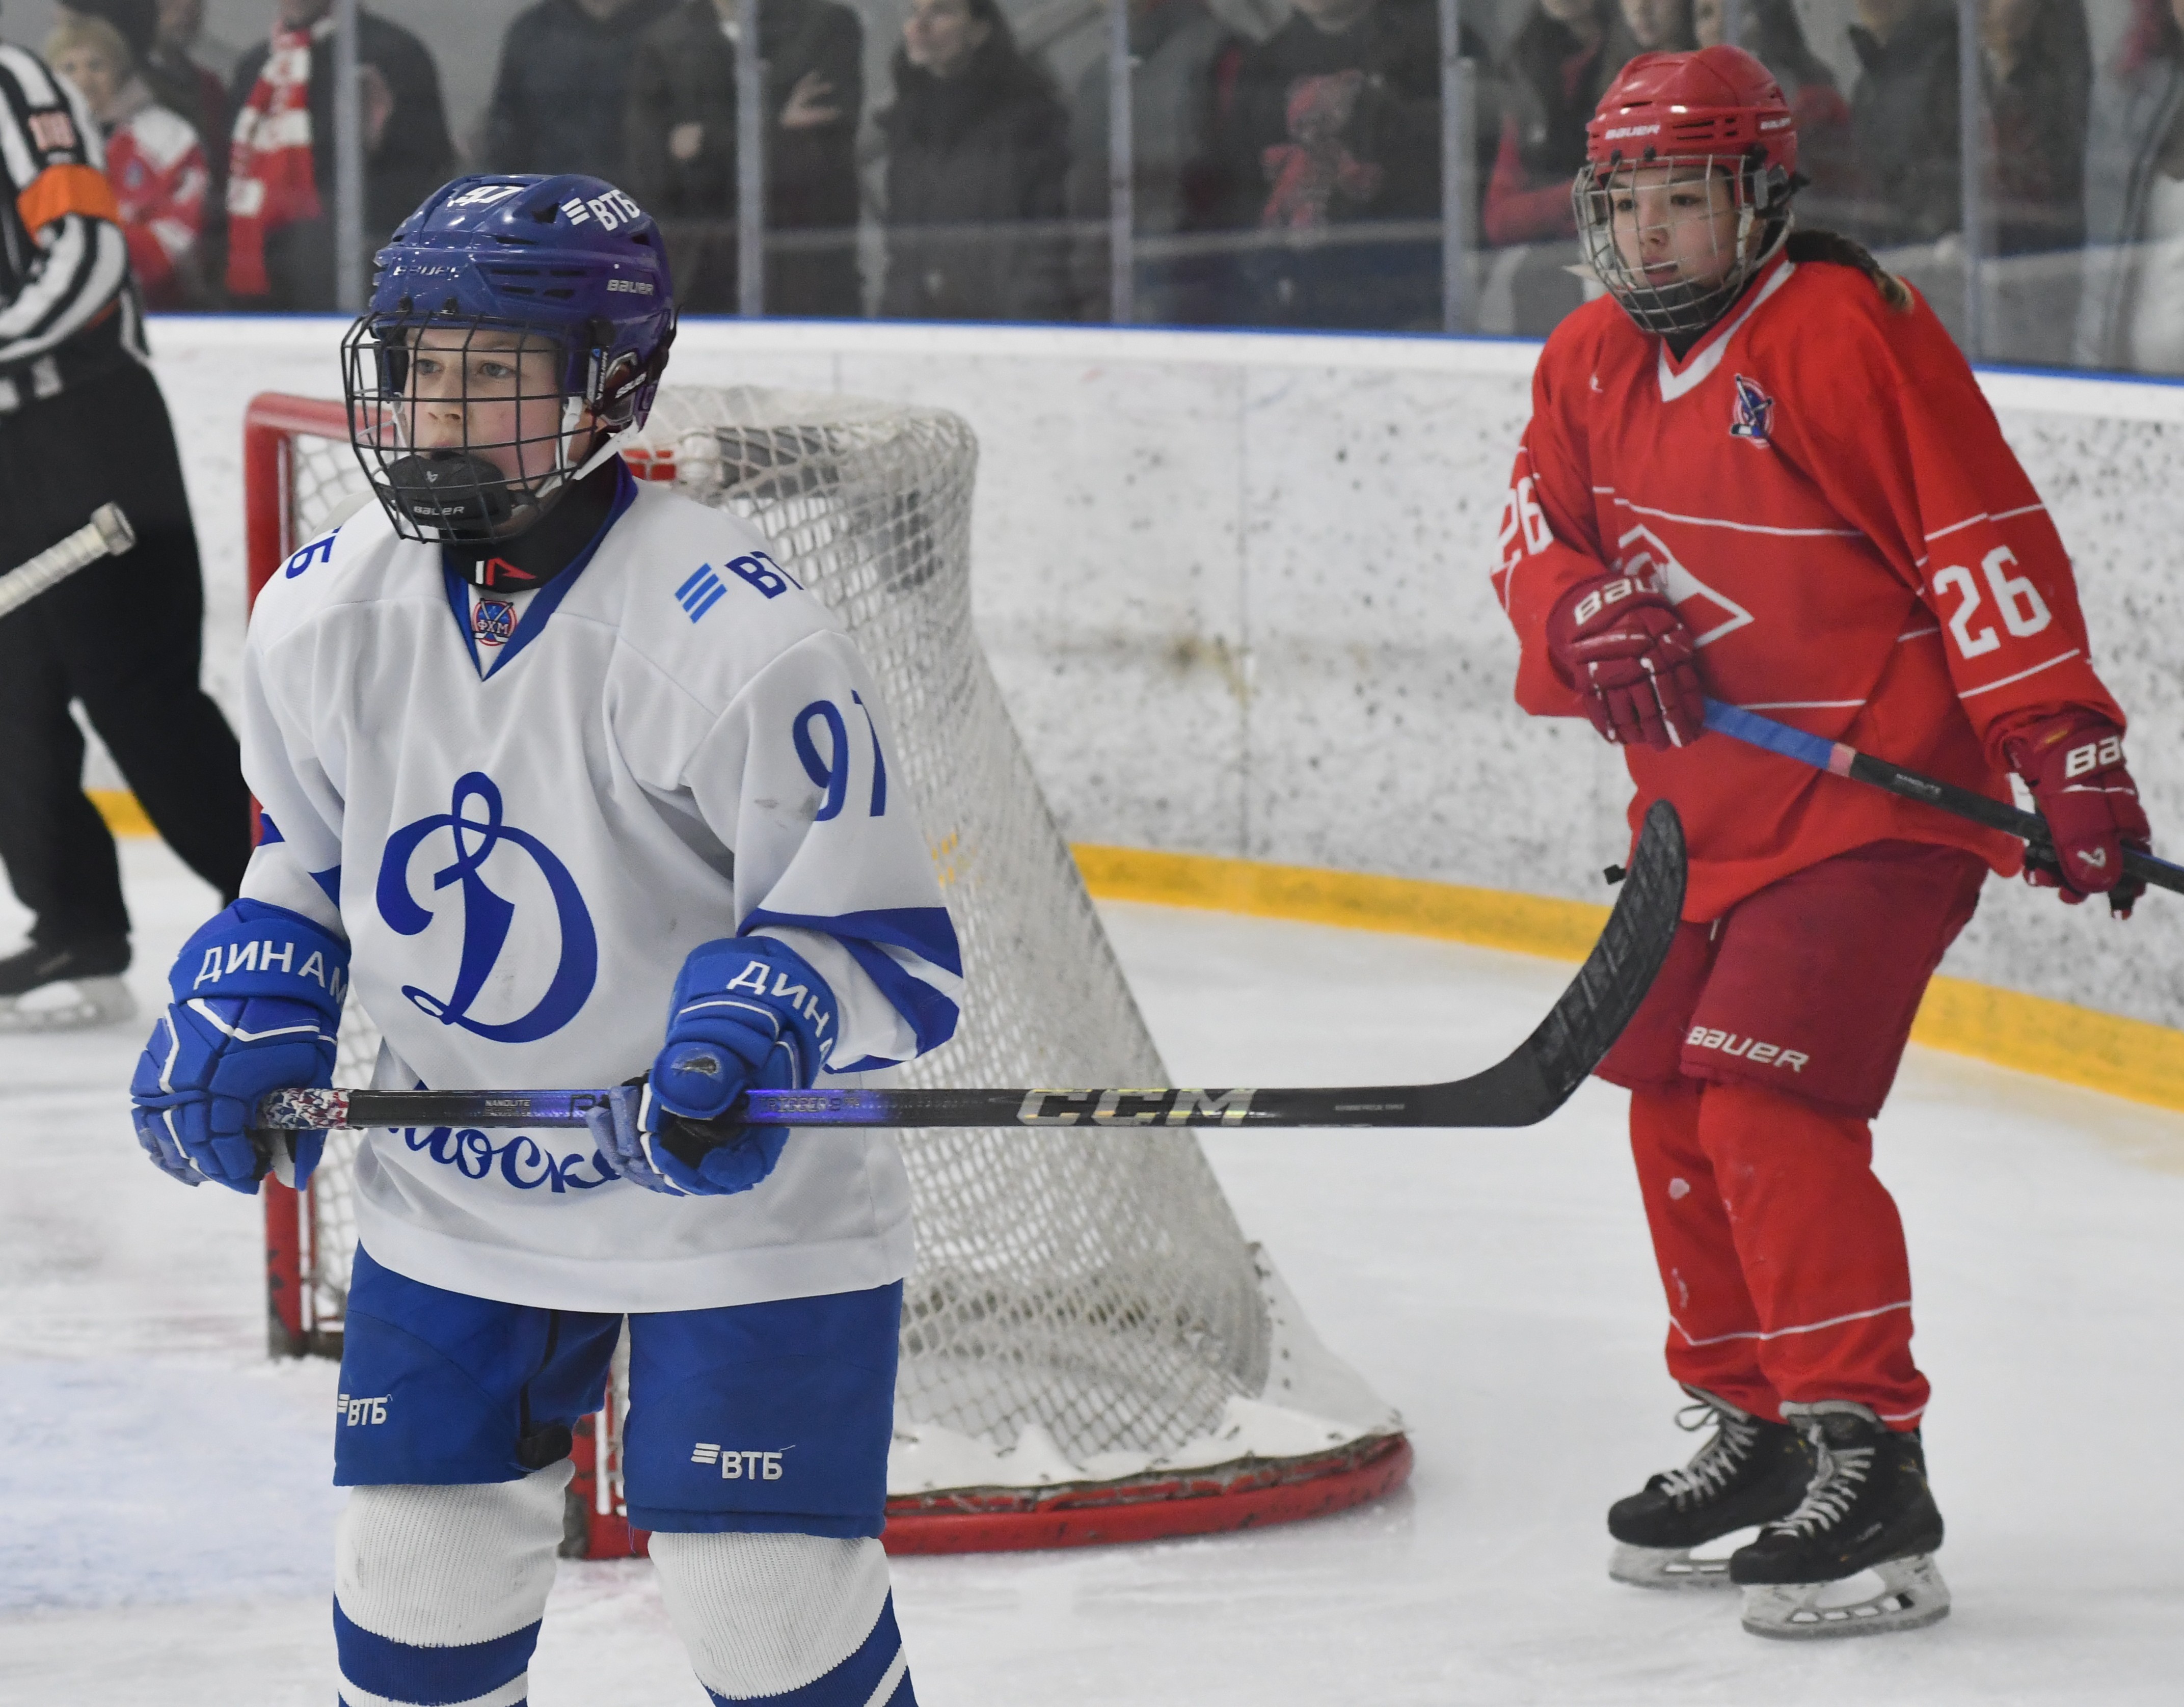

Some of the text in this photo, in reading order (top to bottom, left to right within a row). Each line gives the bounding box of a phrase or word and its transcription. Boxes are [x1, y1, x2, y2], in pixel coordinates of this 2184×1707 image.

[586, 189, 640, 231] ВТБ
[606, 279, 654, 295] BAUER
[413, 506, 465, 516] BAUER
[1933, 545, 2052, 659] 26
[1686, 1026, 1809, 1072] BAUER
[1016, 1088, 1258, 1125] CCM
[347, 1397, 388, 1426] ВТБ
[722, 1451, 783, 1480] ВТБ
